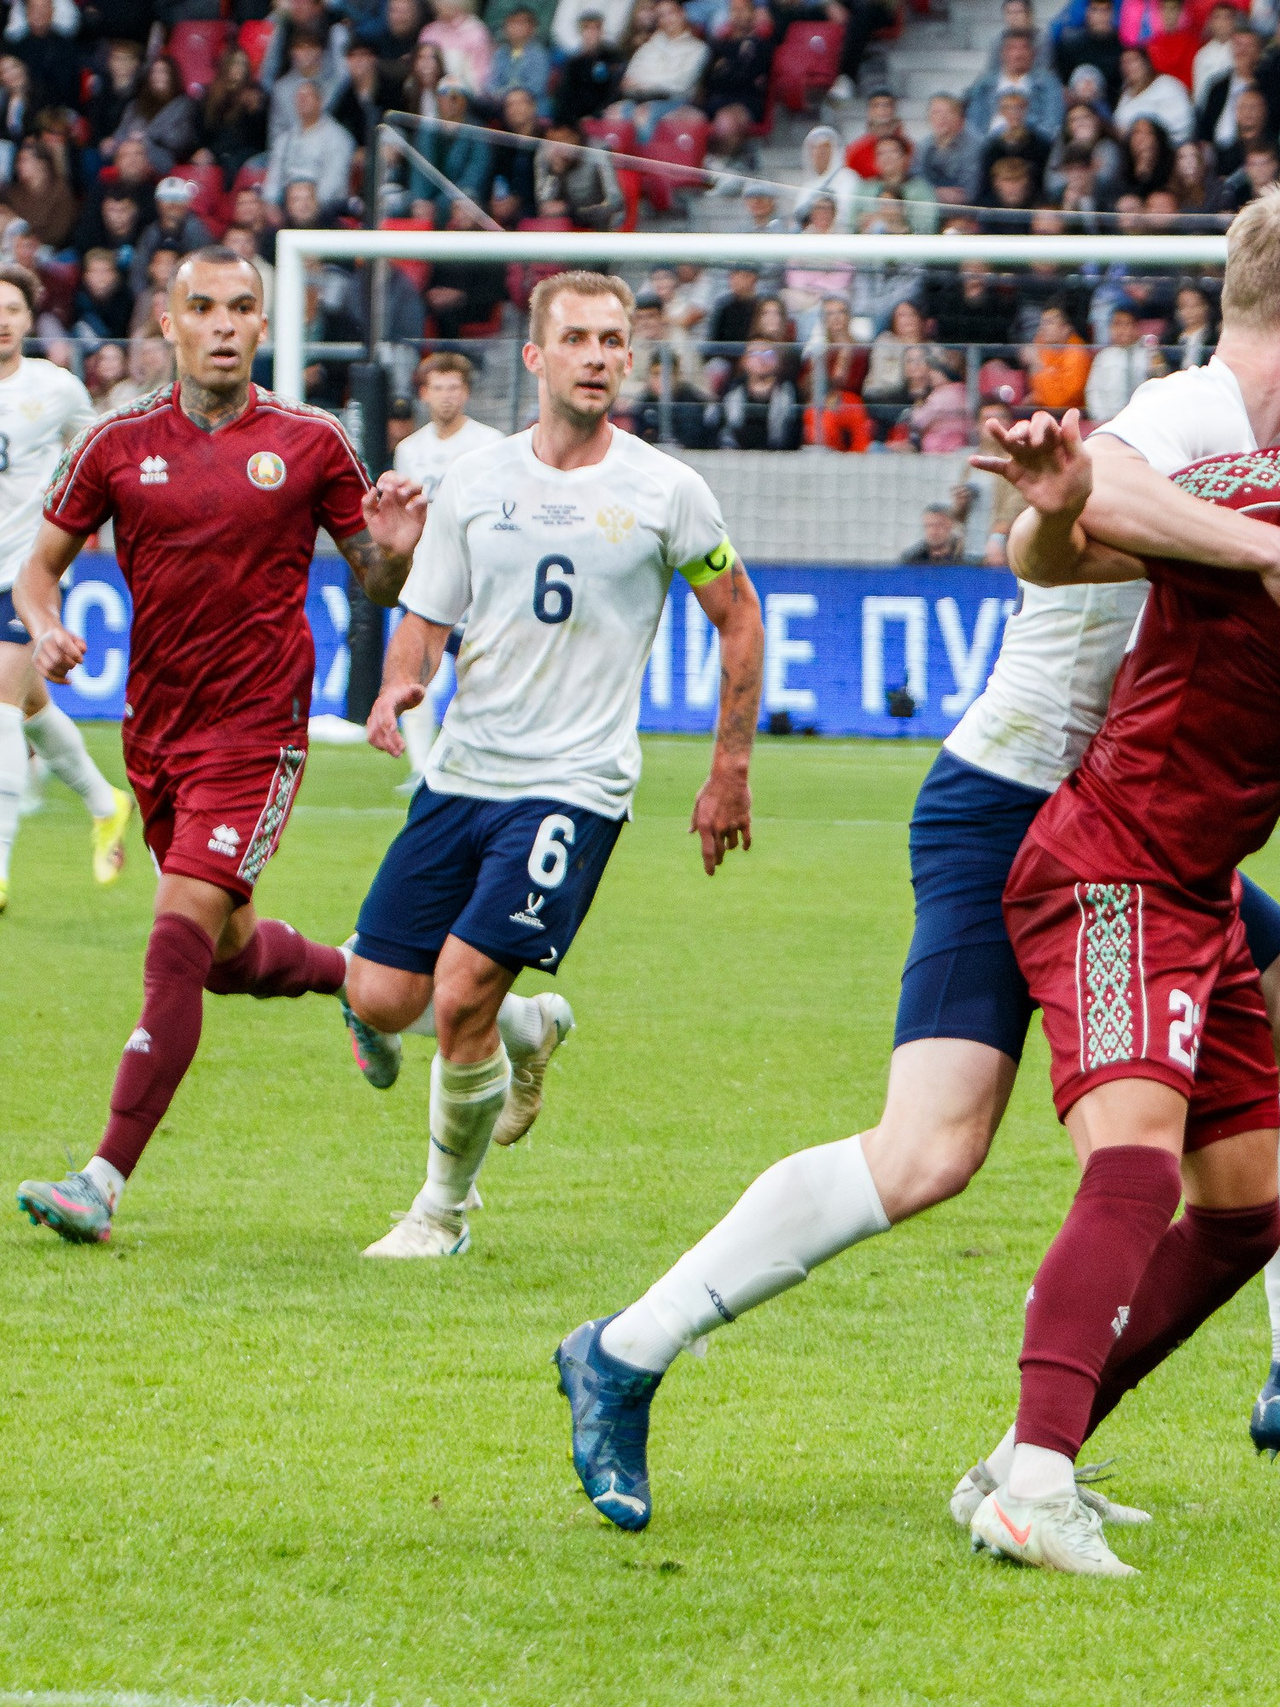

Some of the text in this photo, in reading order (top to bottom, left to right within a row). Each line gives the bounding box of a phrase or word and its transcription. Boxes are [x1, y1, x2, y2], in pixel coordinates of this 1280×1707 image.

[532, 553, 575, 624] 6
[527, 813, 575, 888] 6
[1167, 987, 1201, 1075] 2
